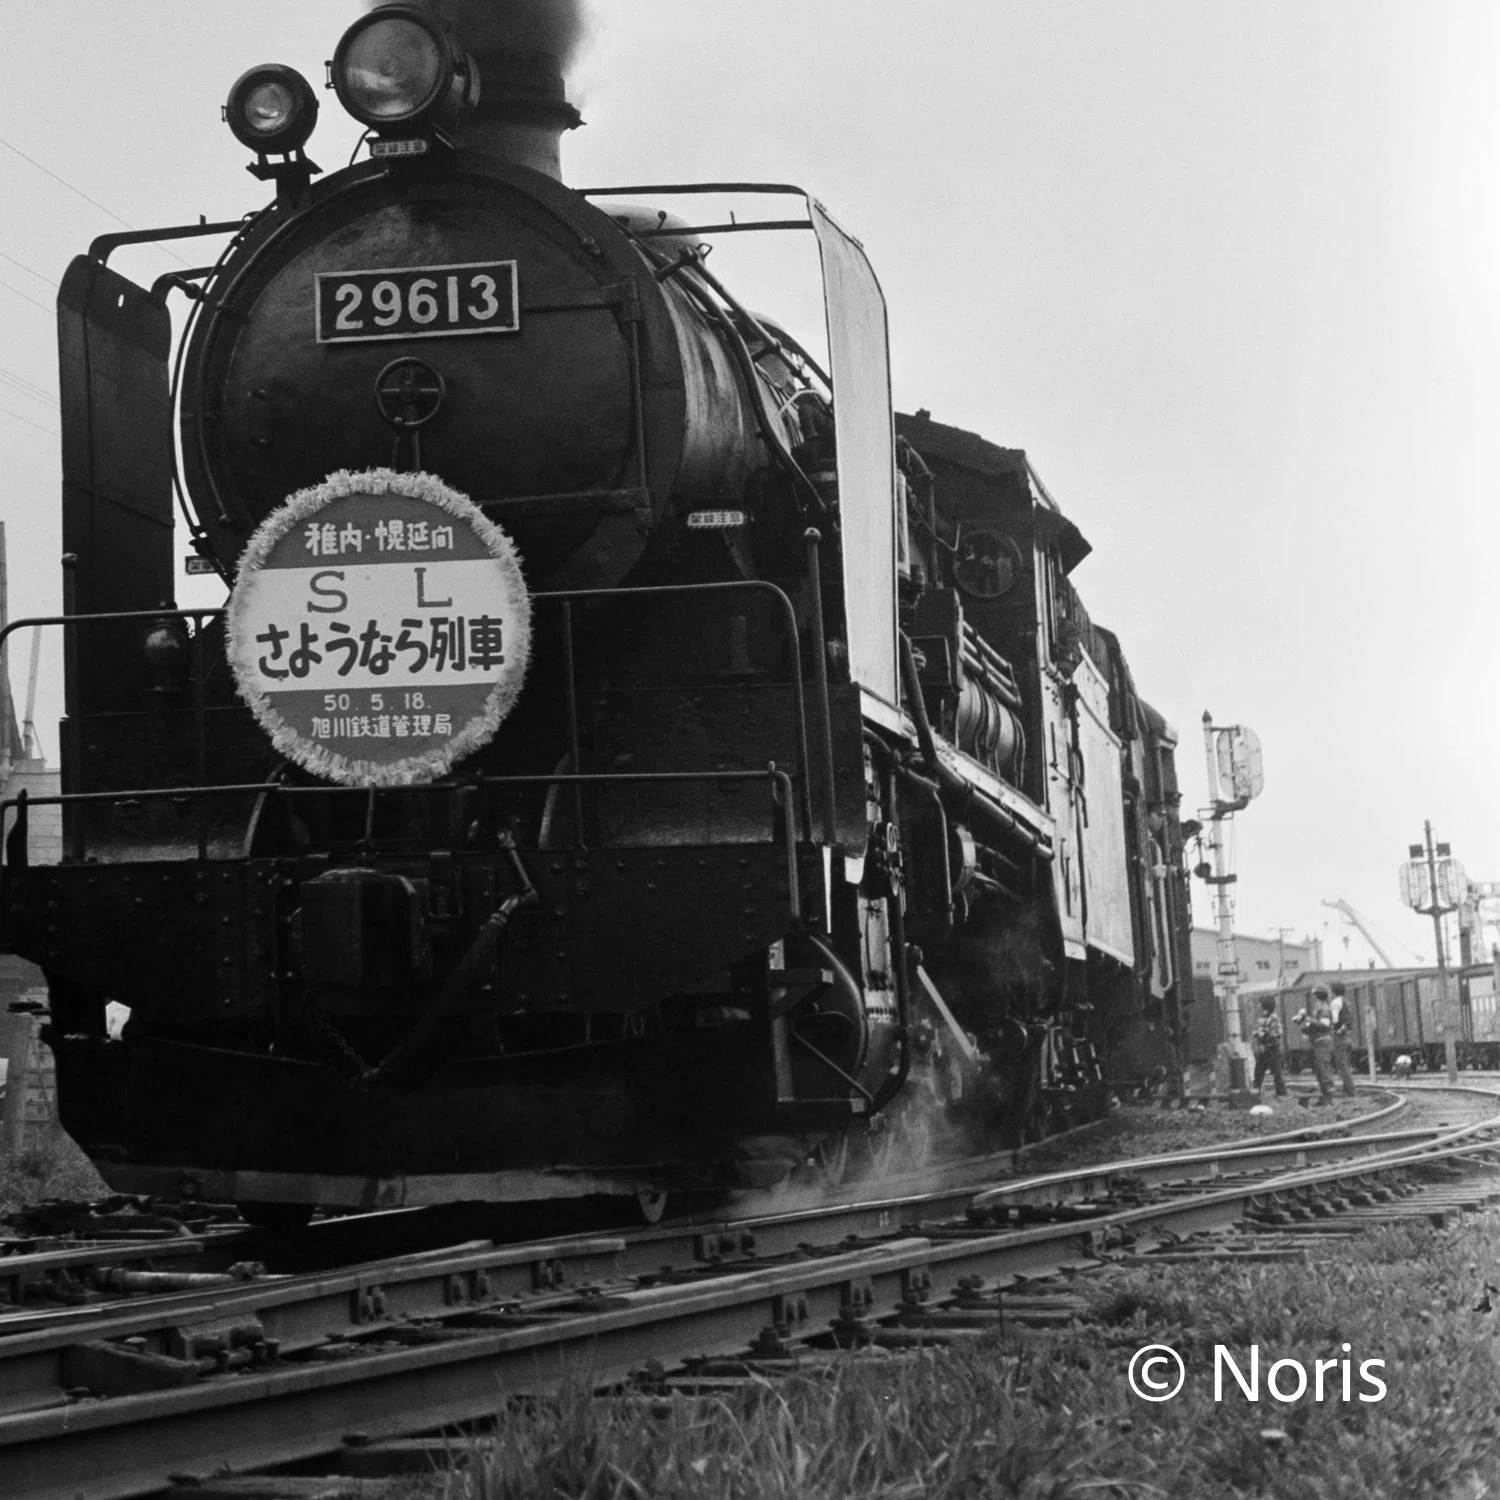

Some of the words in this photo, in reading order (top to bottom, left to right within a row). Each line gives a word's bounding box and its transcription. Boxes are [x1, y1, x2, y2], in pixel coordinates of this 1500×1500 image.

[335, 275, 499, 330] 29613
[256, 614, 504, 679] さようなら列車
[311, 713, 452, 739] 旭川鉄道管理局
